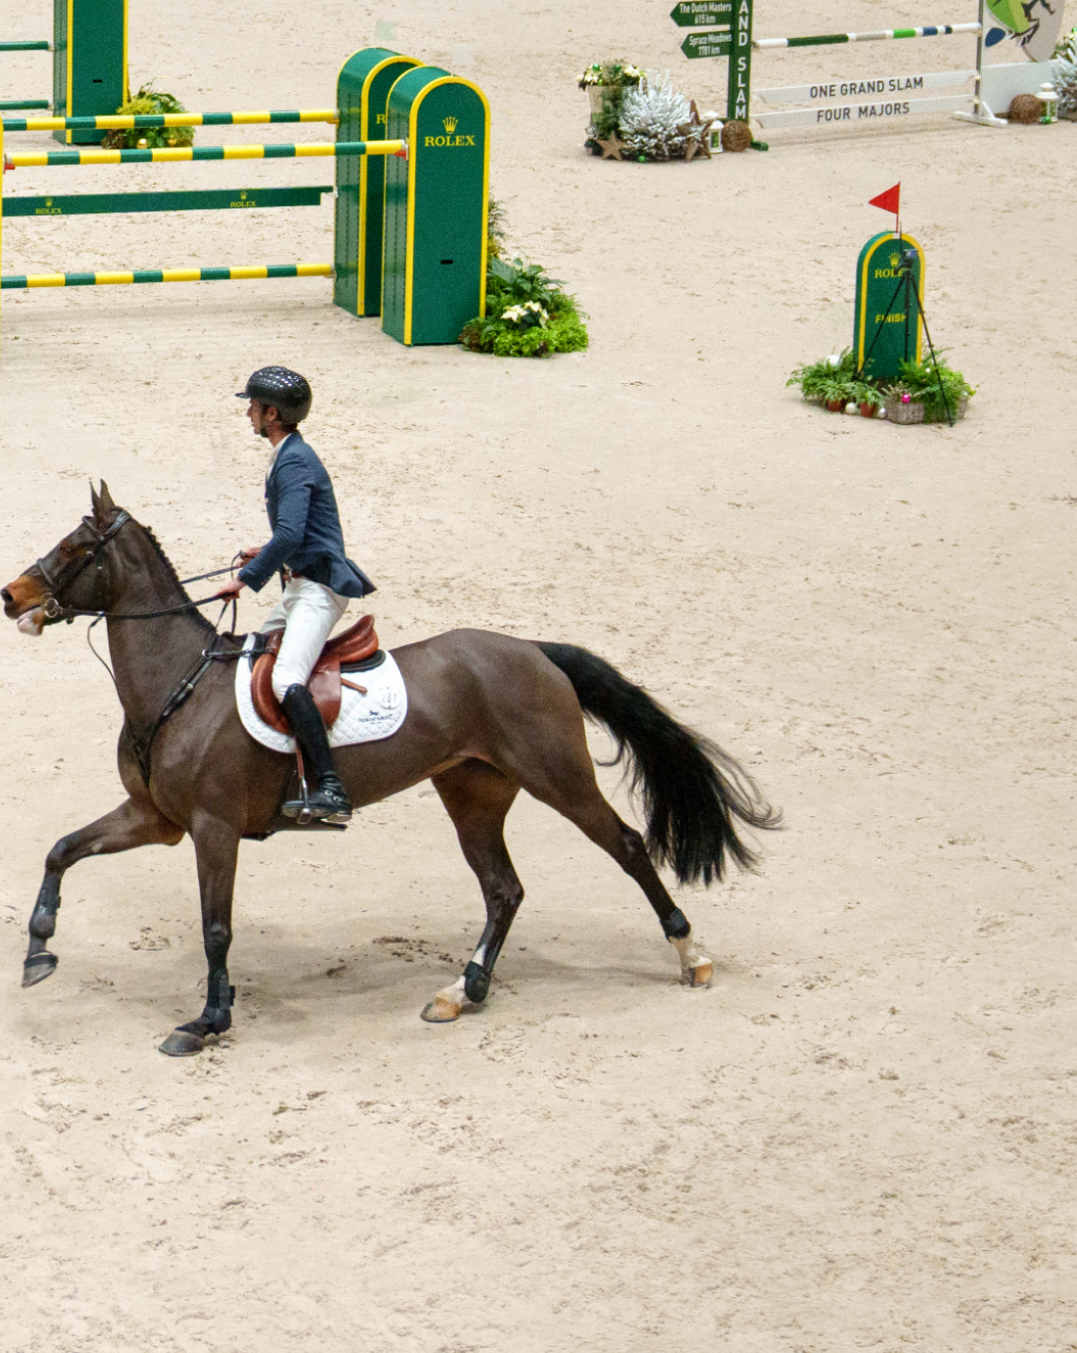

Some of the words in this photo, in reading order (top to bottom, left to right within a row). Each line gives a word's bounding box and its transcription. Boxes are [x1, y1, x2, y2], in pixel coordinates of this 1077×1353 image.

[680, 3, 690, 13] The
[735, 57, 747, 119] SLAM
[810, 84, 836, 98] ONE
[840, 80, 885, 96] GRAND
[888, 77, 923, 92] SLAM
[816, 107, 851, 122] FOUR
[858, 101, 910, 118] MAJORS
[424, 135, 476, 147] ROLEX
[230, 200, 256, 208] ROLEX
[35, 207, 62, 215] ROLEX
